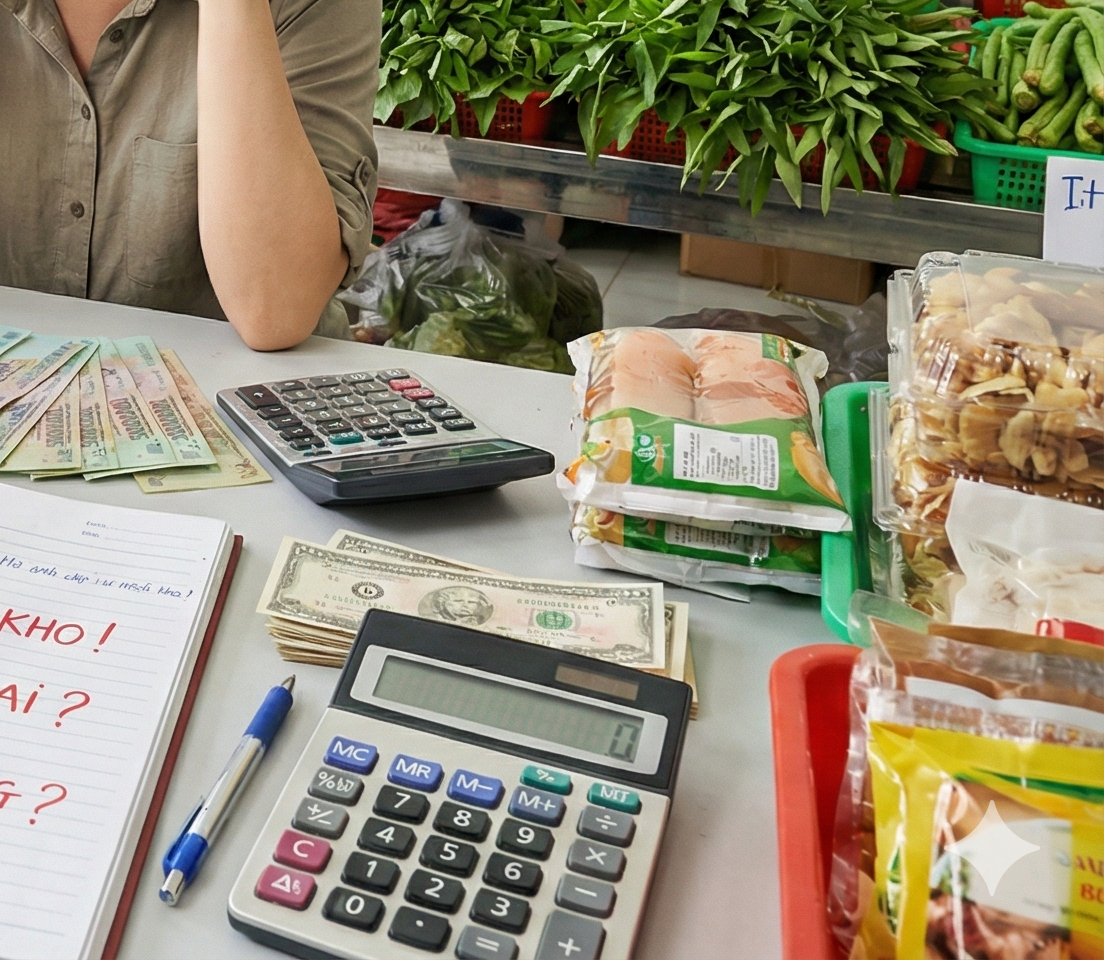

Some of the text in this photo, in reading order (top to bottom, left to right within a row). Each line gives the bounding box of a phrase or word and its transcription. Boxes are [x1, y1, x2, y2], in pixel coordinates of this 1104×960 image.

[332, 740, 370, 762] MC
[608, 722, 641, 763] 0
[395, 758, 432, 780] MR
[395, 792, 411, 809] 7
[518, 791, 556, 812] M+
[453, 809, 471, 827] 8
[376, 826, 395, 844] 4
[517, 826, 535, 844] 9
[293, 840, 314, 858] C
[440, 844, 459, 861] 5
[367, 861, 378, 878] 1
[504, 862, 523, 881] 6
[424, 878, 444, 898] 2
[345, 895, 365, 915] 0
[490, 897, 511, 917] 3
